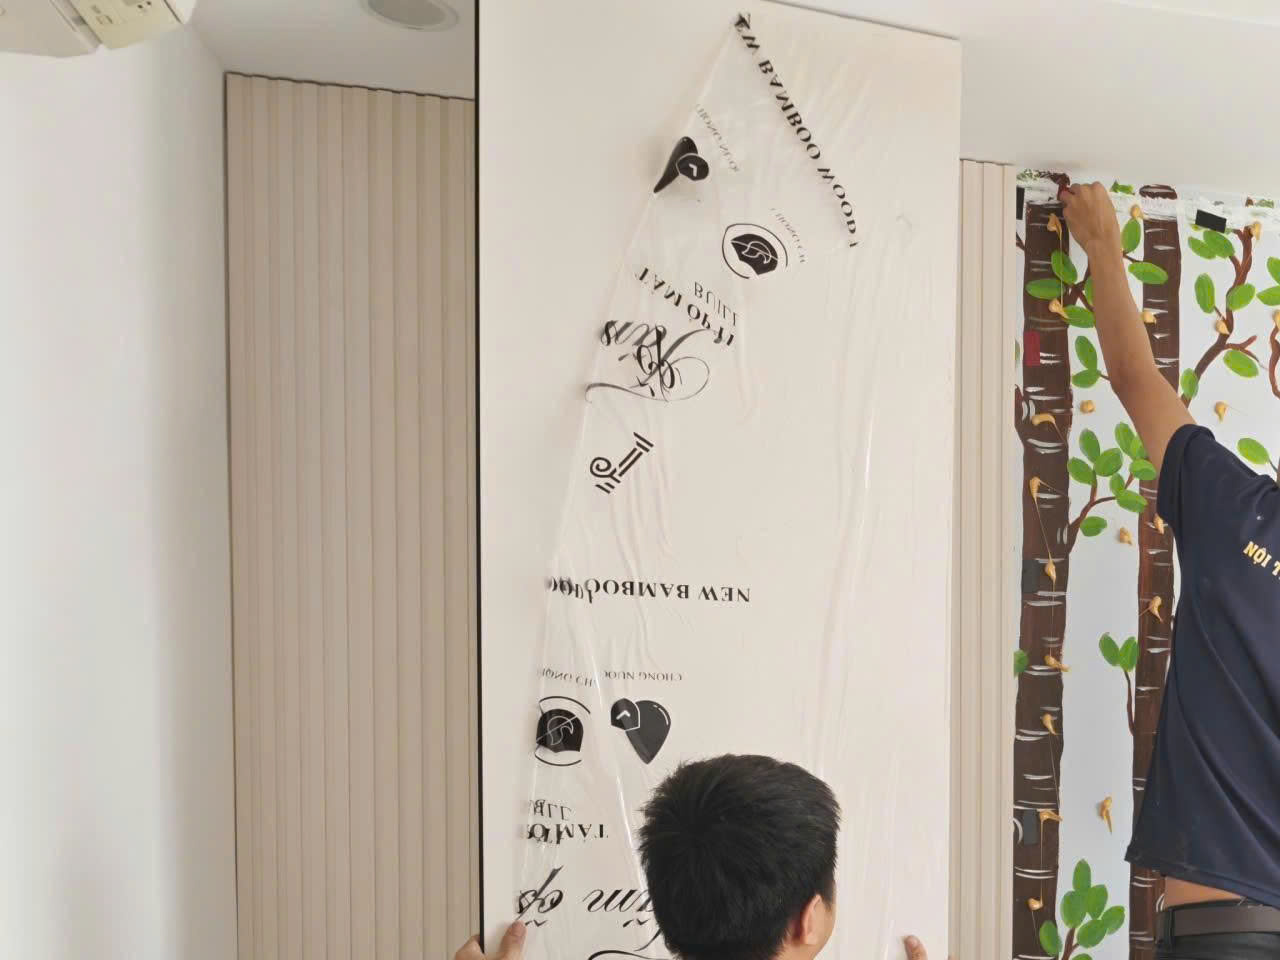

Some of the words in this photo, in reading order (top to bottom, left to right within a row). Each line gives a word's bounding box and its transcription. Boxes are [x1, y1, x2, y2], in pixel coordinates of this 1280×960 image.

[1243, 541, 1273, 568] NỘI
[584, 578, 690, 600] BAMBOO
[700, 585, 750, 602] NEW
